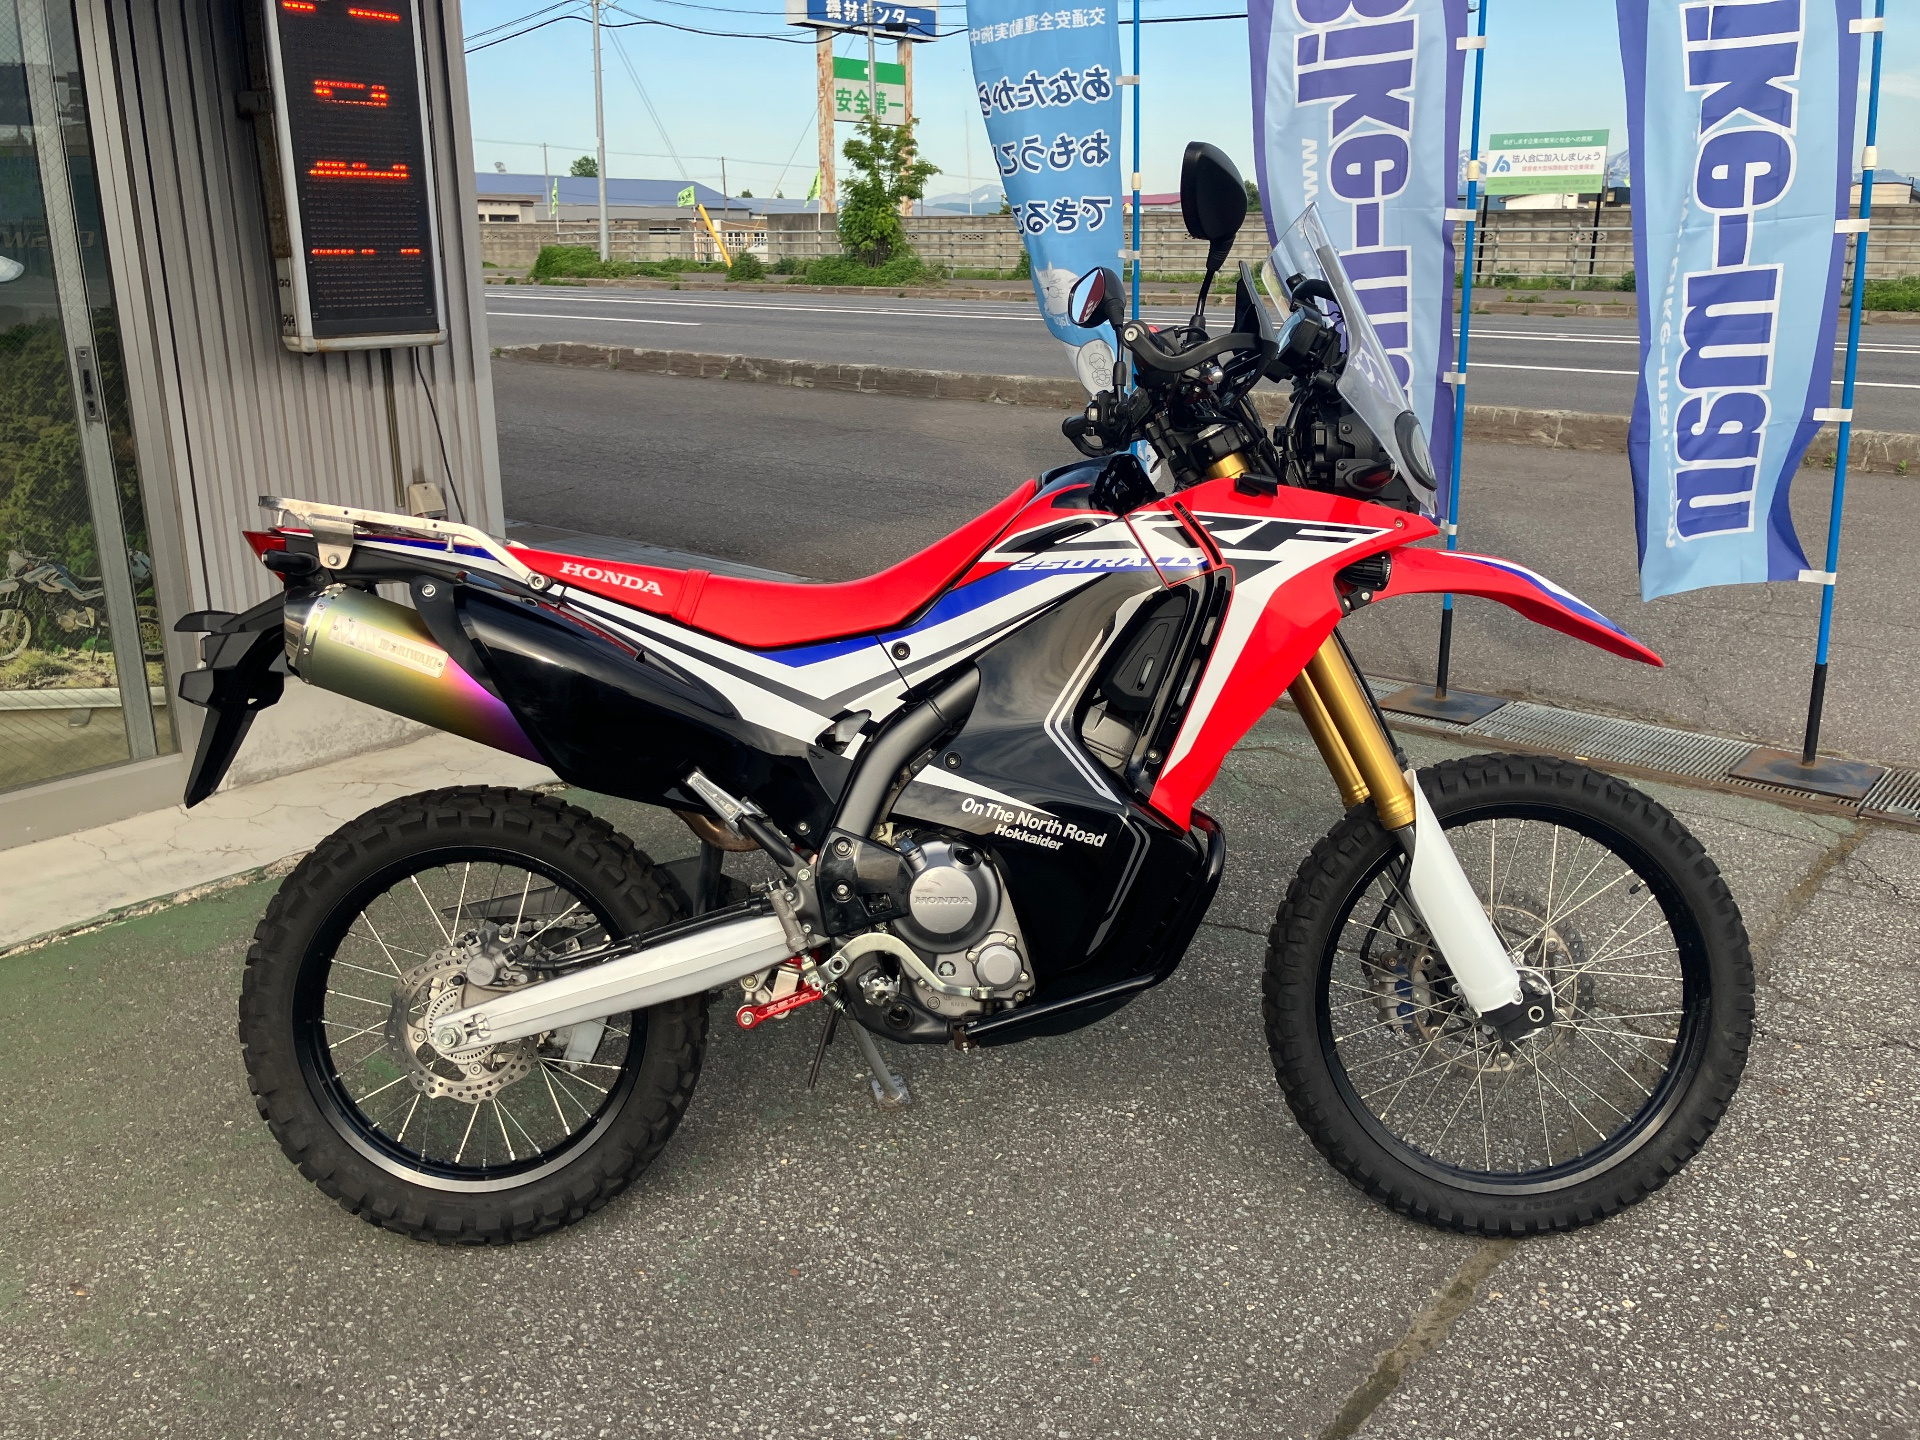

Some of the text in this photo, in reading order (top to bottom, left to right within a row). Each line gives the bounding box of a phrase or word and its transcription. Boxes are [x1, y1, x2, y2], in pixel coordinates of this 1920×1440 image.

[836, 88, 904, 116] 安全第一
[1512, 151, 1601, 163] 法人会に加入しましょう
[560, 561, 664, 597] HONDA
[961, 797, 1108, 848] On The North Road
[994, 823, 1064, 851] Hokkaider
[914, 896, 973, 905] HONDA
